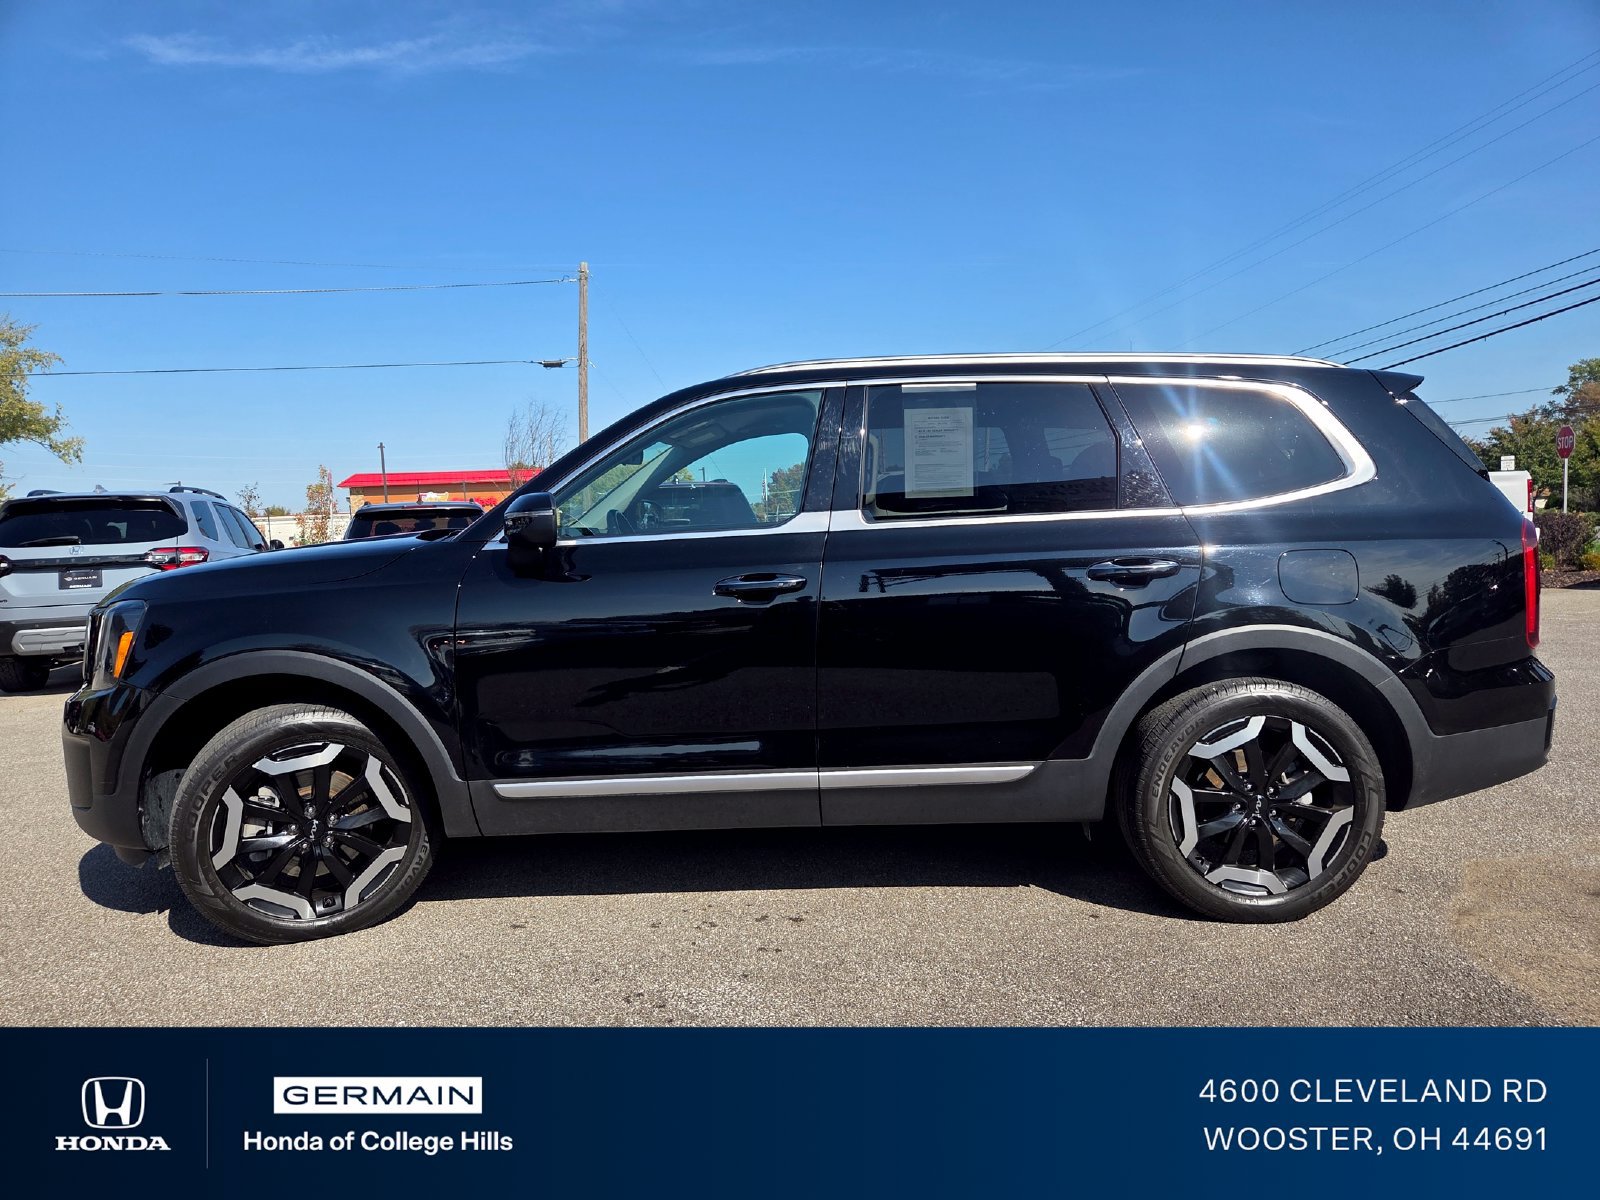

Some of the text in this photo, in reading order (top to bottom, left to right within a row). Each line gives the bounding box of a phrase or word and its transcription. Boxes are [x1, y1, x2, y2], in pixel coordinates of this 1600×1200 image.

[1557, 436, 1573, 449] STOP
[1152, 717, 1205, 798] ENDEAVOR
[188, 753, 238, 841] COOPER
[1309, 830, 1372, 906] COOPER
